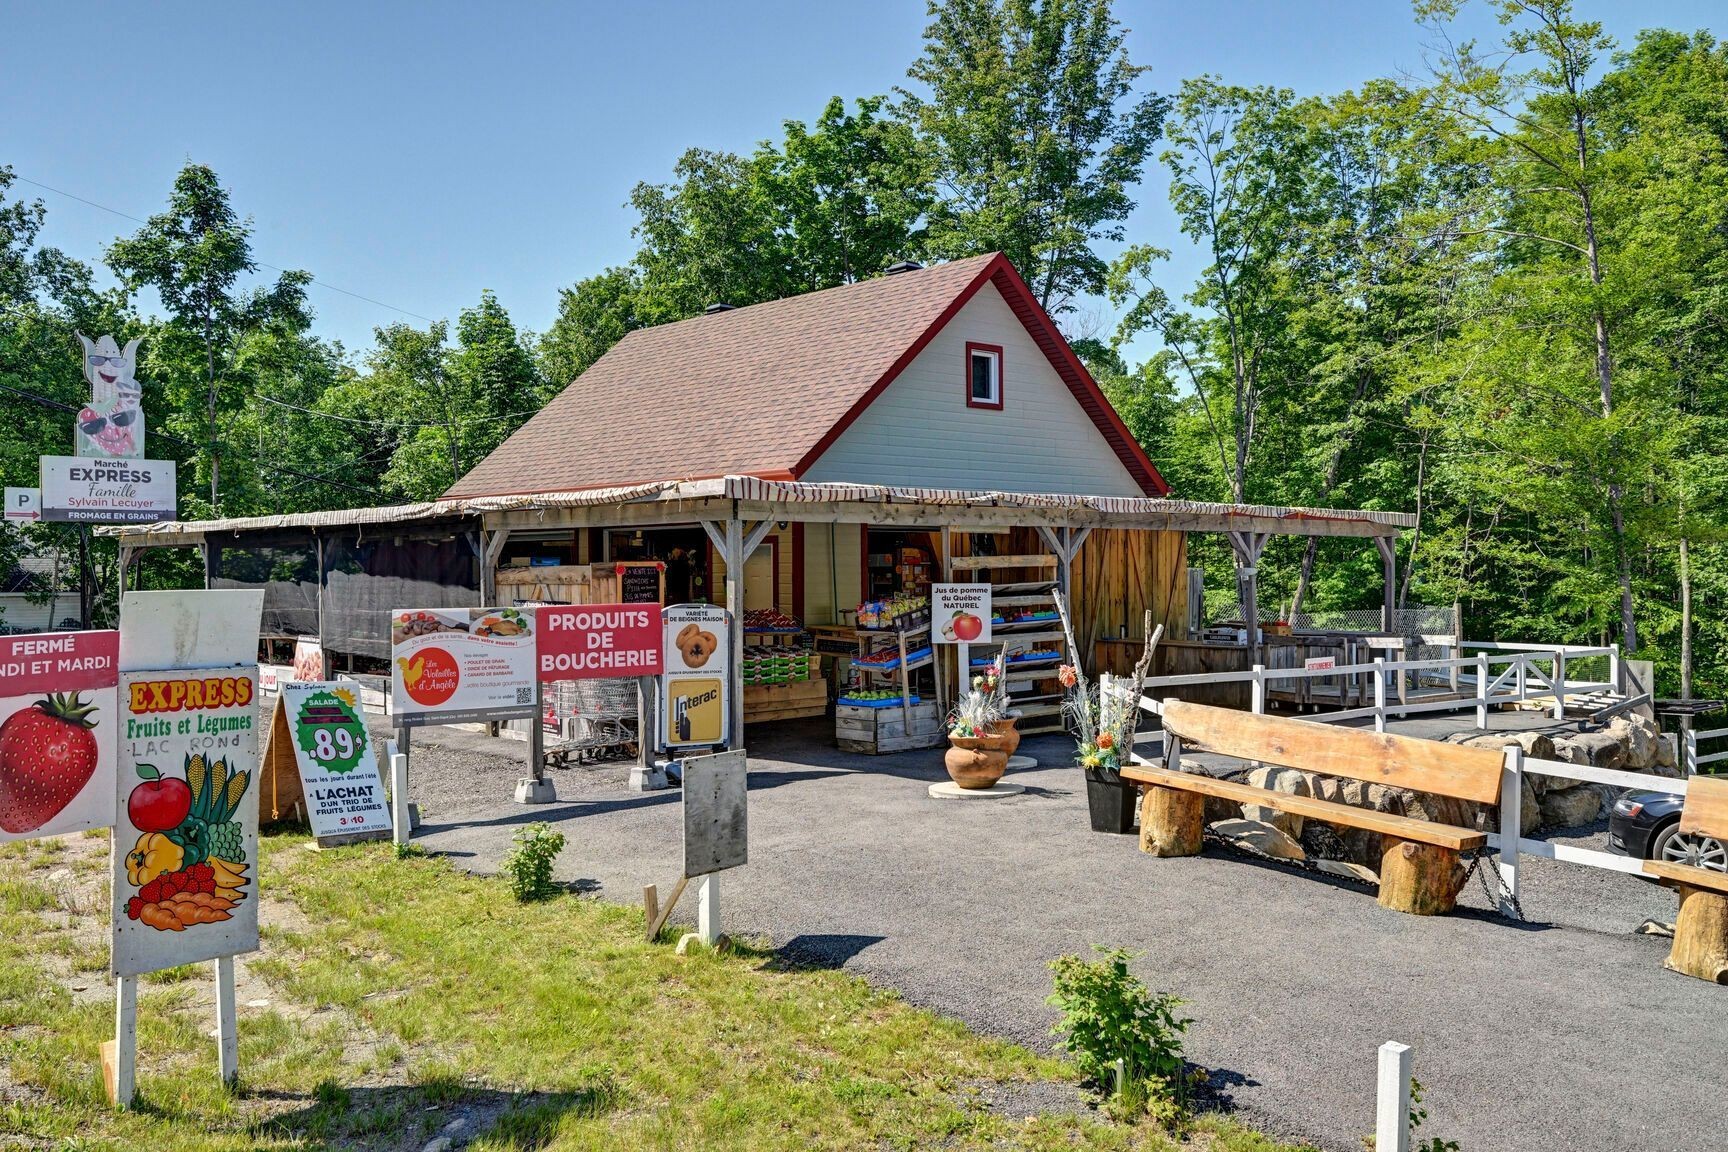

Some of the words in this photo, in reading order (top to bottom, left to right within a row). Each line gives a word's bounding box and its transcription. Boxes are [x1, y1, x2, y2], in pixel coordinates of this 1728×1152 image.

[94, 460, 128, 469] Marché
[69, 468, 152, 483] EXPRESS
[88, 482, 137, 498] Famille
[18, 495, 30, 507] P
[68, 497, 108, 507] Sylvain
[112, 498, 154, 508] Lecuyer
[549, 611, 649, 631] PRODUITS
[12, 635, 75, 656] FERMÉ
[587, 632, 613, 650] DE
[32, 661, 52, 674] ET
[58, 656, 111, 672] MARDI
[426, 660, 437, 668] Les
[541, 649, 658, 672] BOUCHERIE
[424, 668, 457, 678] Volailles
[419, 679, 456, 691] d'Angèle
[129, 677, 253, 714] EXPRESS
[127, 717, 171, 739] Fruits
[178, 718, 191, 734] et
[197, 714, 251, 736] Légumes
[132, 740, 169, 757] LAC
[315, 786, 373, 800] L'ACHAT
